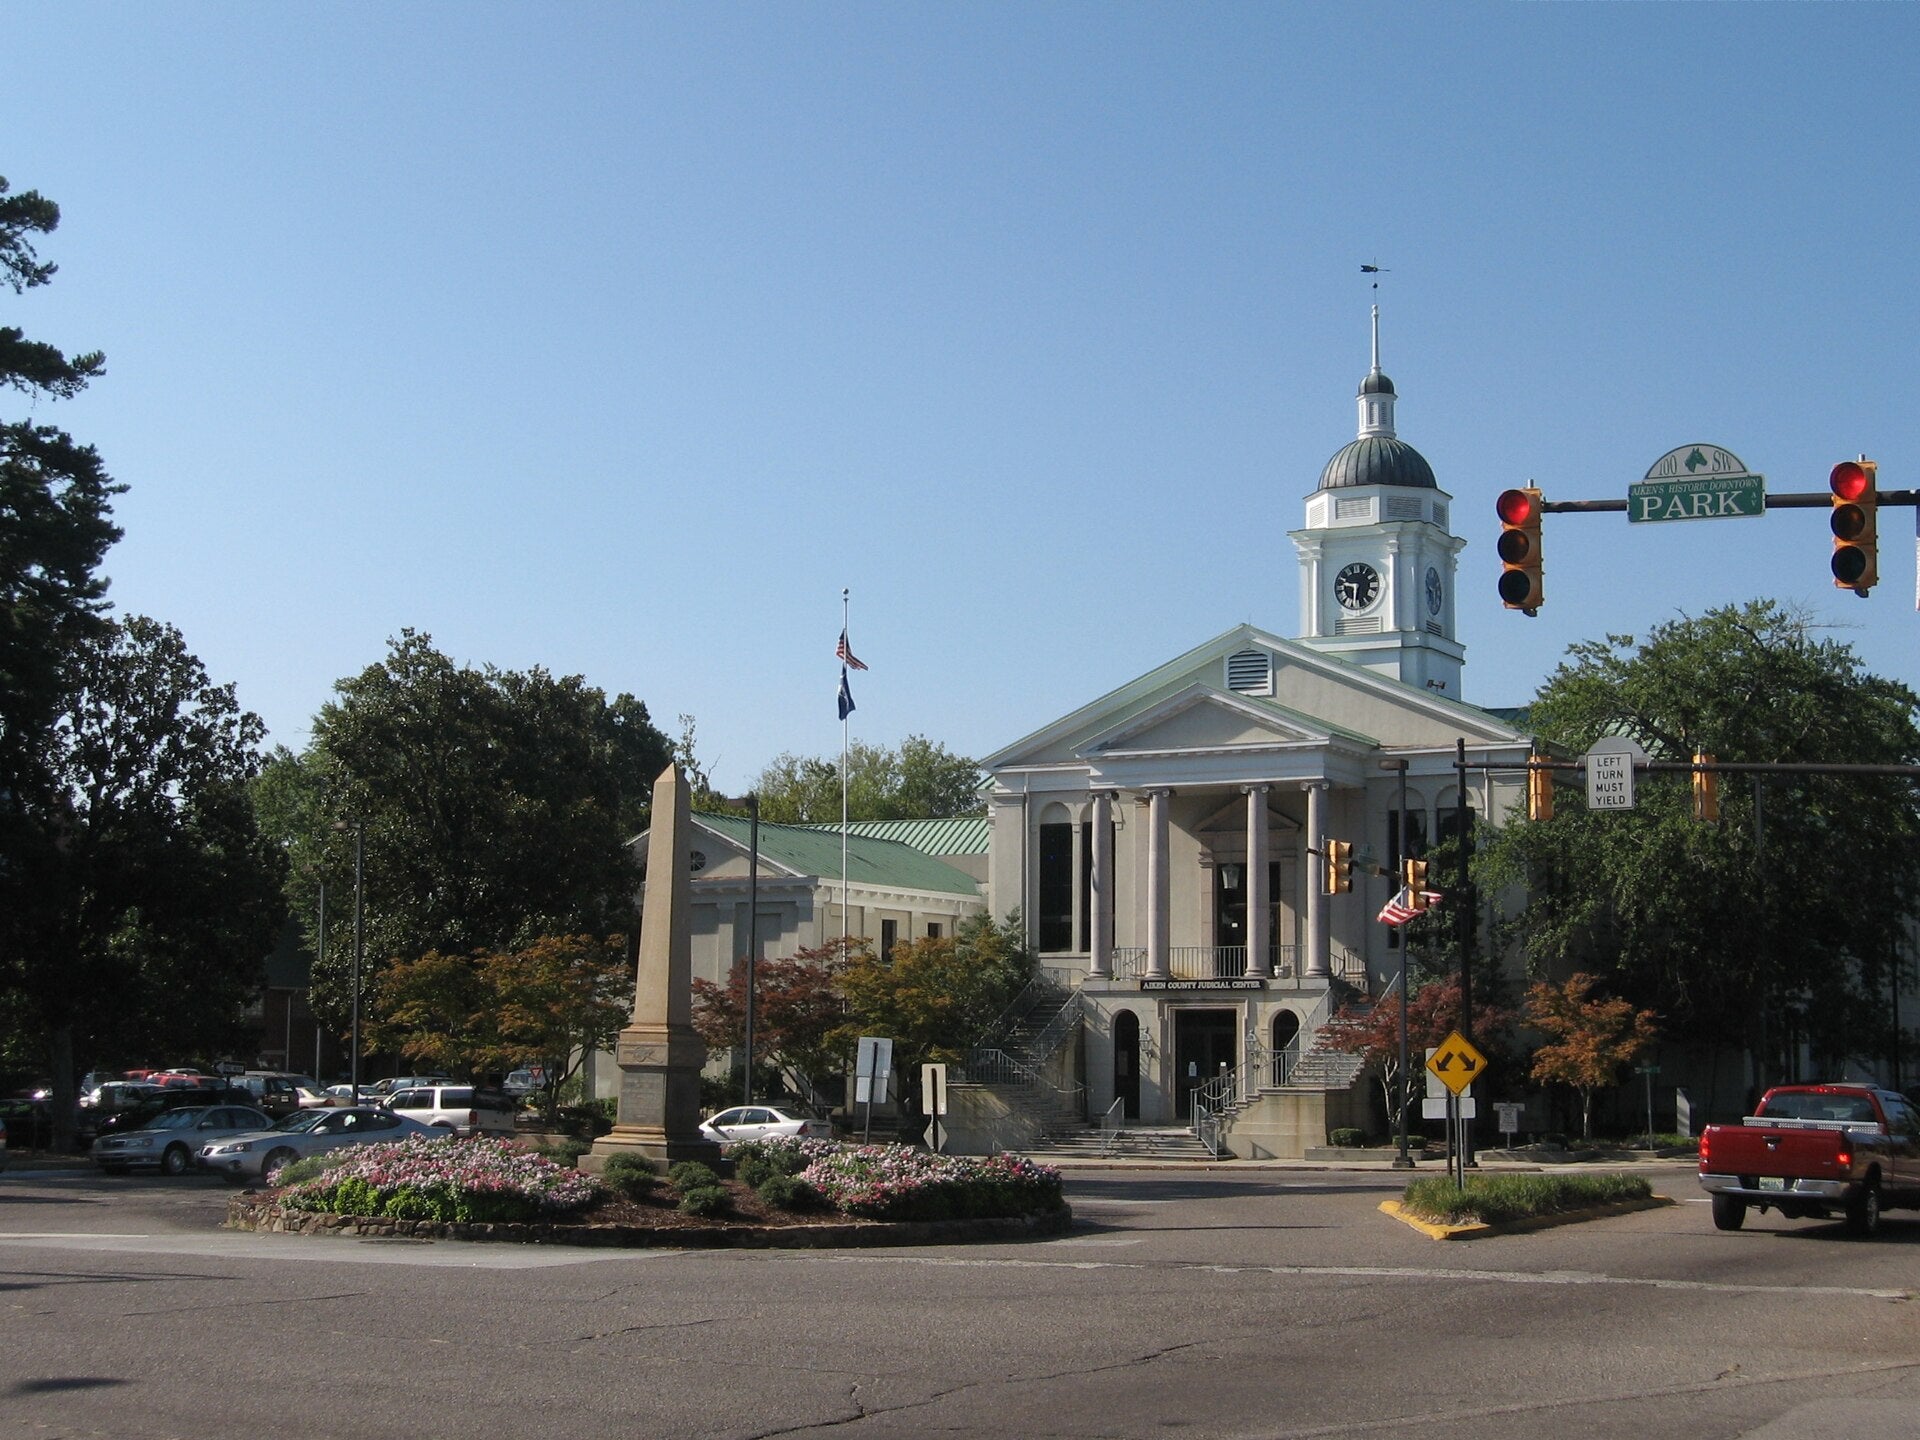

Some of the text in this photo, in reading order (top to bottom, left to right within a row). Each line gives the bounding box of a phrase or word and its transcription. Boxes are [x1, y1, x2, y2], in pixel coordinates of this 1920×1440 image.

[1659, 450, 1731, 475] 100 SW
[1668, 482, 1708, 493] HISTORIC
[1709, 478, 1759, 490] DOWNTOWN
[1640, 491, 1744, 520] PARK
[1597, 757, 1621, 767] LEFT
[1596, 770, 1623, 780] TURN
[1596, 783, 1623, 792] MUST
[1596, 795, 1625, 805] YIELD
[1143, 980, 1261, 990] AIKEN COUNTY JUDICIAL CENTER
